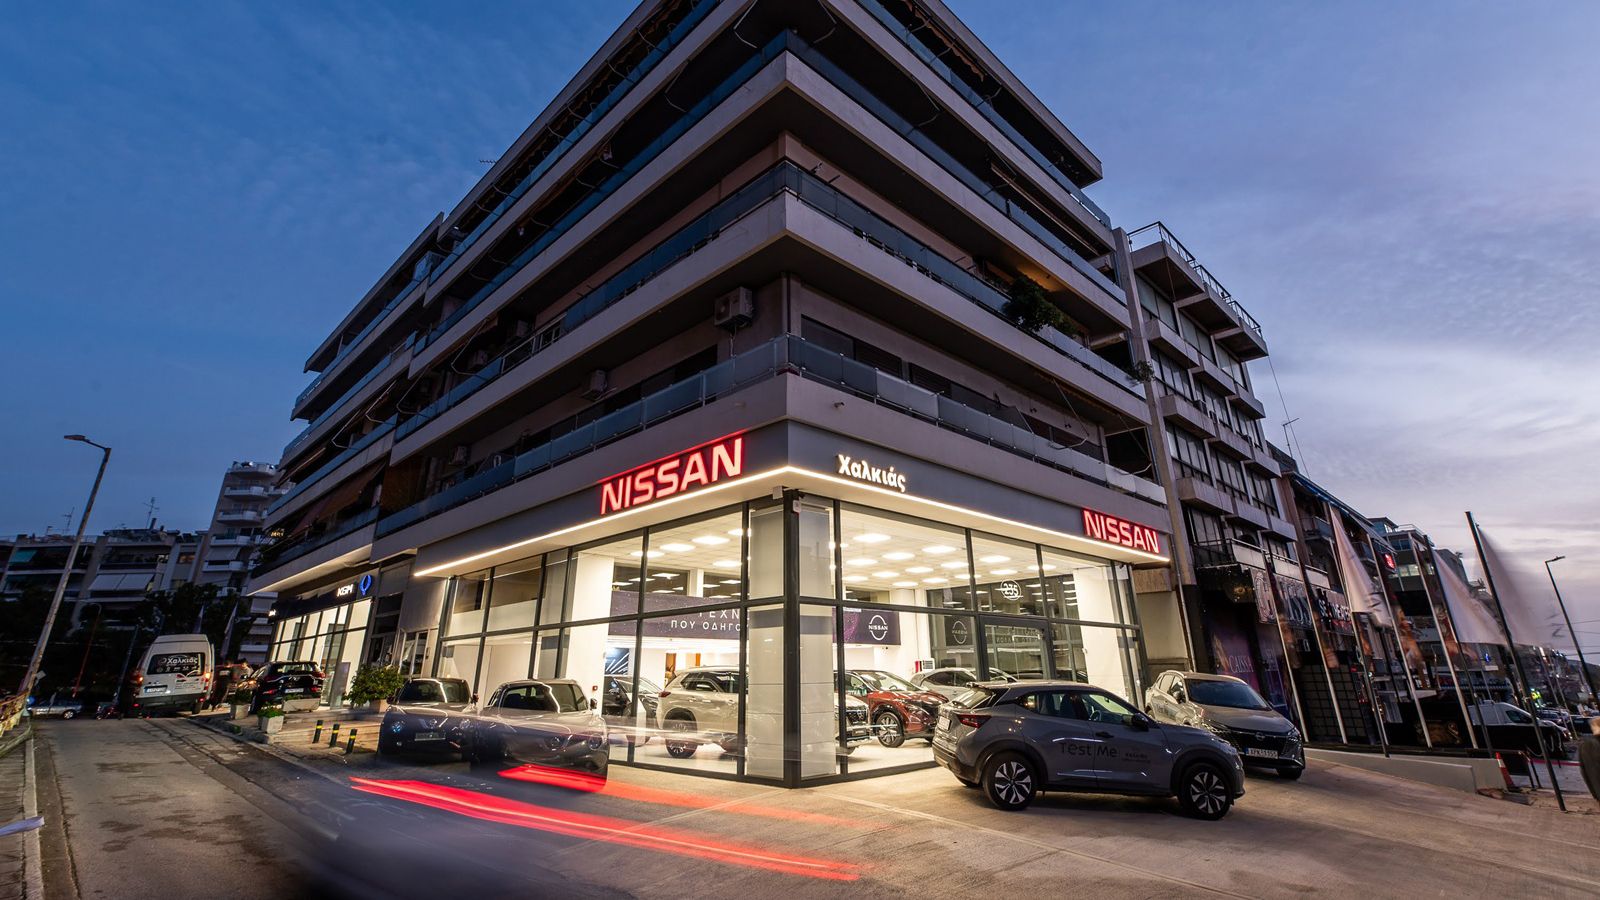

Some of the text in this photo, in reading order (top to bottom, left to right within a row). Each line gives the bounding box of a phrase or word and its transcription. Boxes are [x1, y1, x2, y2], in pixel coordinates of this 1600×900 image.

[600, 437, 743, 516] NISSAN
[838, 453, 906, 493] Χαλκιάς
[1083, 509, 1160, 554] NISSAN
[670, 619, 696, 630] ΠΟΥ
[1060, 742, 1093, 757] Test
[1096, 745, 1119, 758] Me
